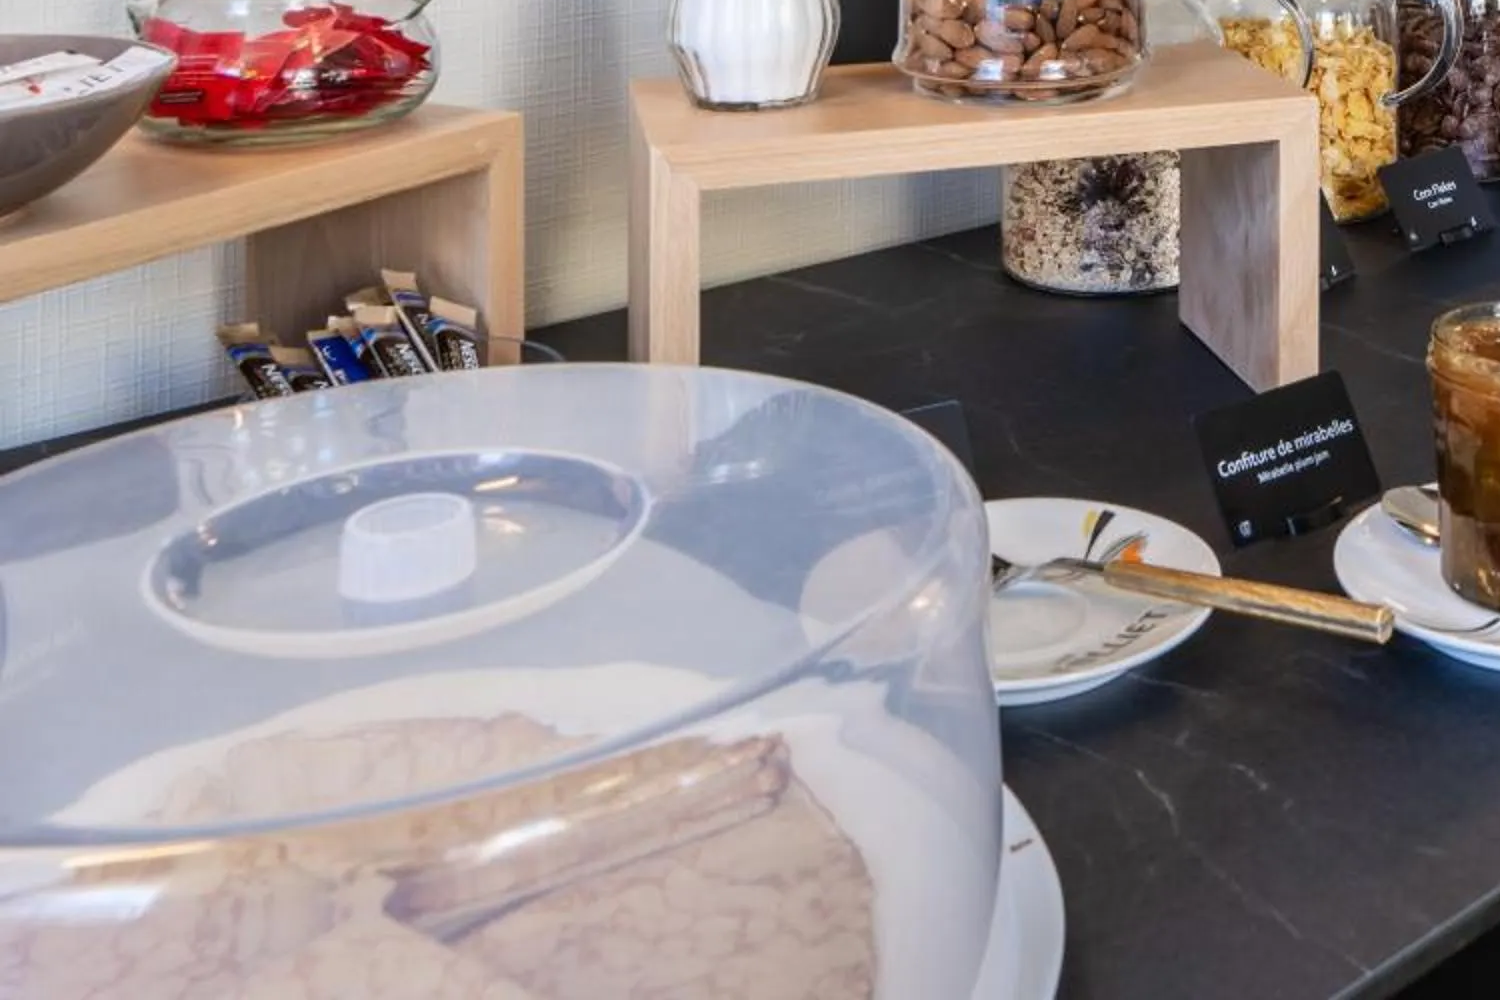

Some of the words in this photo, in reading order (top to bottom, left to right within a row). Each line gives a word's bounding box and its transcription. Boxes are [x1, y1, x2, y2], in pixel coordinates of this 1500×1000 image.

[1217, 451, 1277, 478] Confiture
[1277, 439, 1295, 457] de
[1294, 418, 1355, 449] mirabelles
